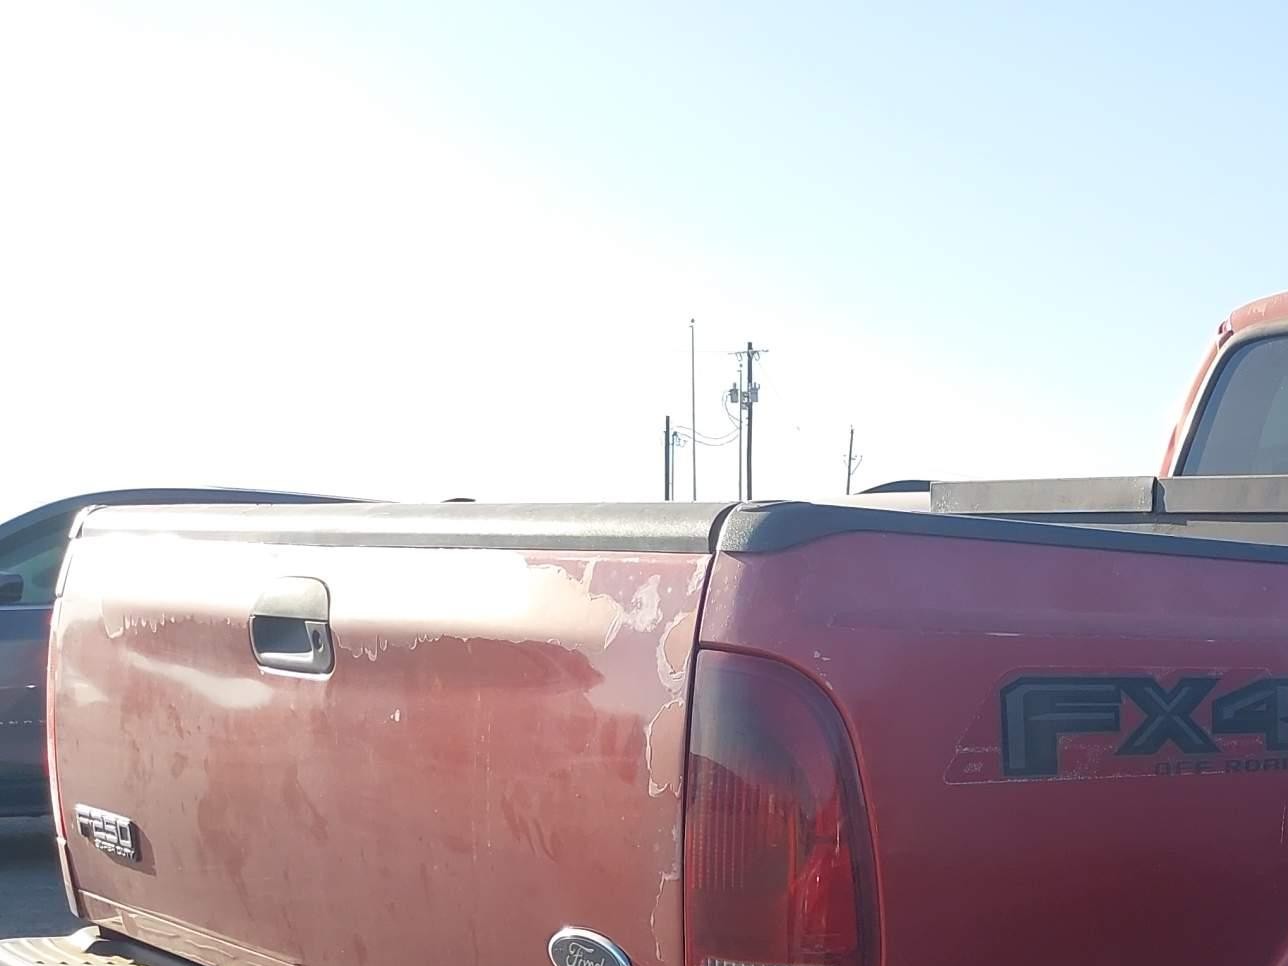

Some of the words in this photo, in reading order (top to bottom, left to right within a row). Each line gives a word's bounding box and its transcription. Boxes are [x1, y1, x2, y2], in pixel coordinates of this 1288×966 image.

[1154, 758, 1215, 775] OFF
[94, 837, 116, 855] SUPER
[115, 845, 135, 861] DUTY
